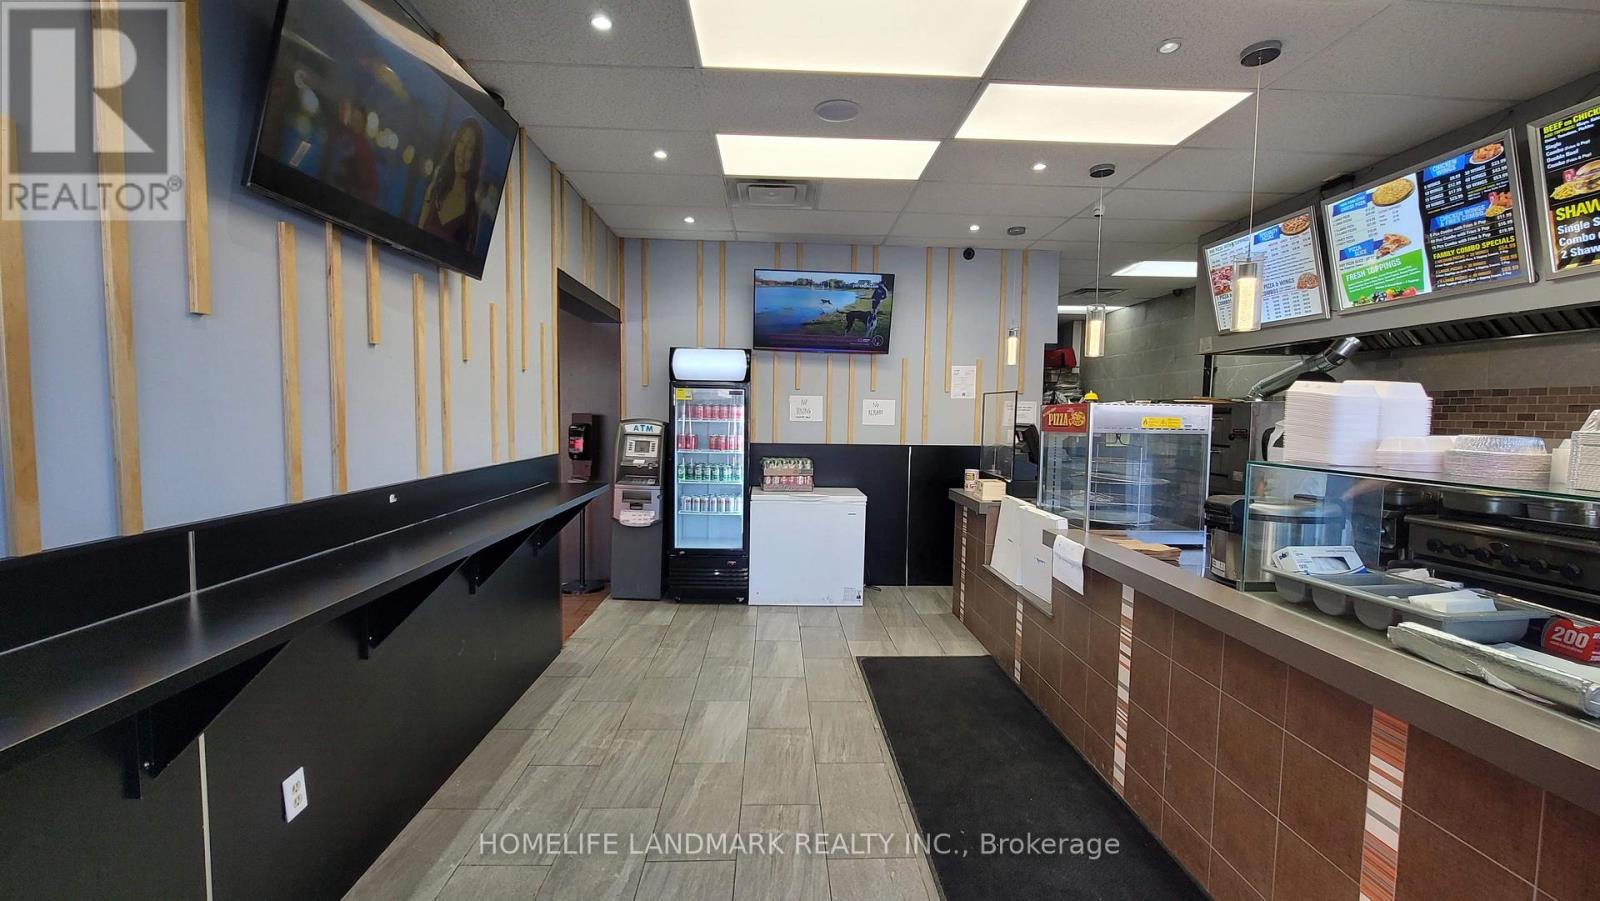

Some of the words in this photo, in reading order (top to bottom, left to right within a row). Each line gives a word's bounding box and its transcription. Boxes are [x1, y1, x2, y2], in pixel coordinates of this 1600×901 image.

[1543, 121, 1563, 134] BEEF
[1545, 142, 1562, 151] Single
[1546, 148, 1564, 156] Combo
[1547, 160, 1566, 169] Combo
[1557, 221, 1590, 235] Single
[1559, 233, 1595, 246] Combo
[1433, 249, 1455, 260] FAMILY
[1456, 243, 1480, 255] COMBO
[1481, 235, 1515, 248] SPECIALS
[1560, 250, 1568, 259] 2
[1570, 244, 1600, 257] Shaw
[1346, 270, 1366, 282] FRESH
[1367, 258, 1401, 274] TOPPINGS
[1280, 278, 1295, 286] WINGS
[1048, 413, 1068, 426] PIZZA
[633, 424, 654, 432] ATM
[1551, 626, 1590, 649] 200
